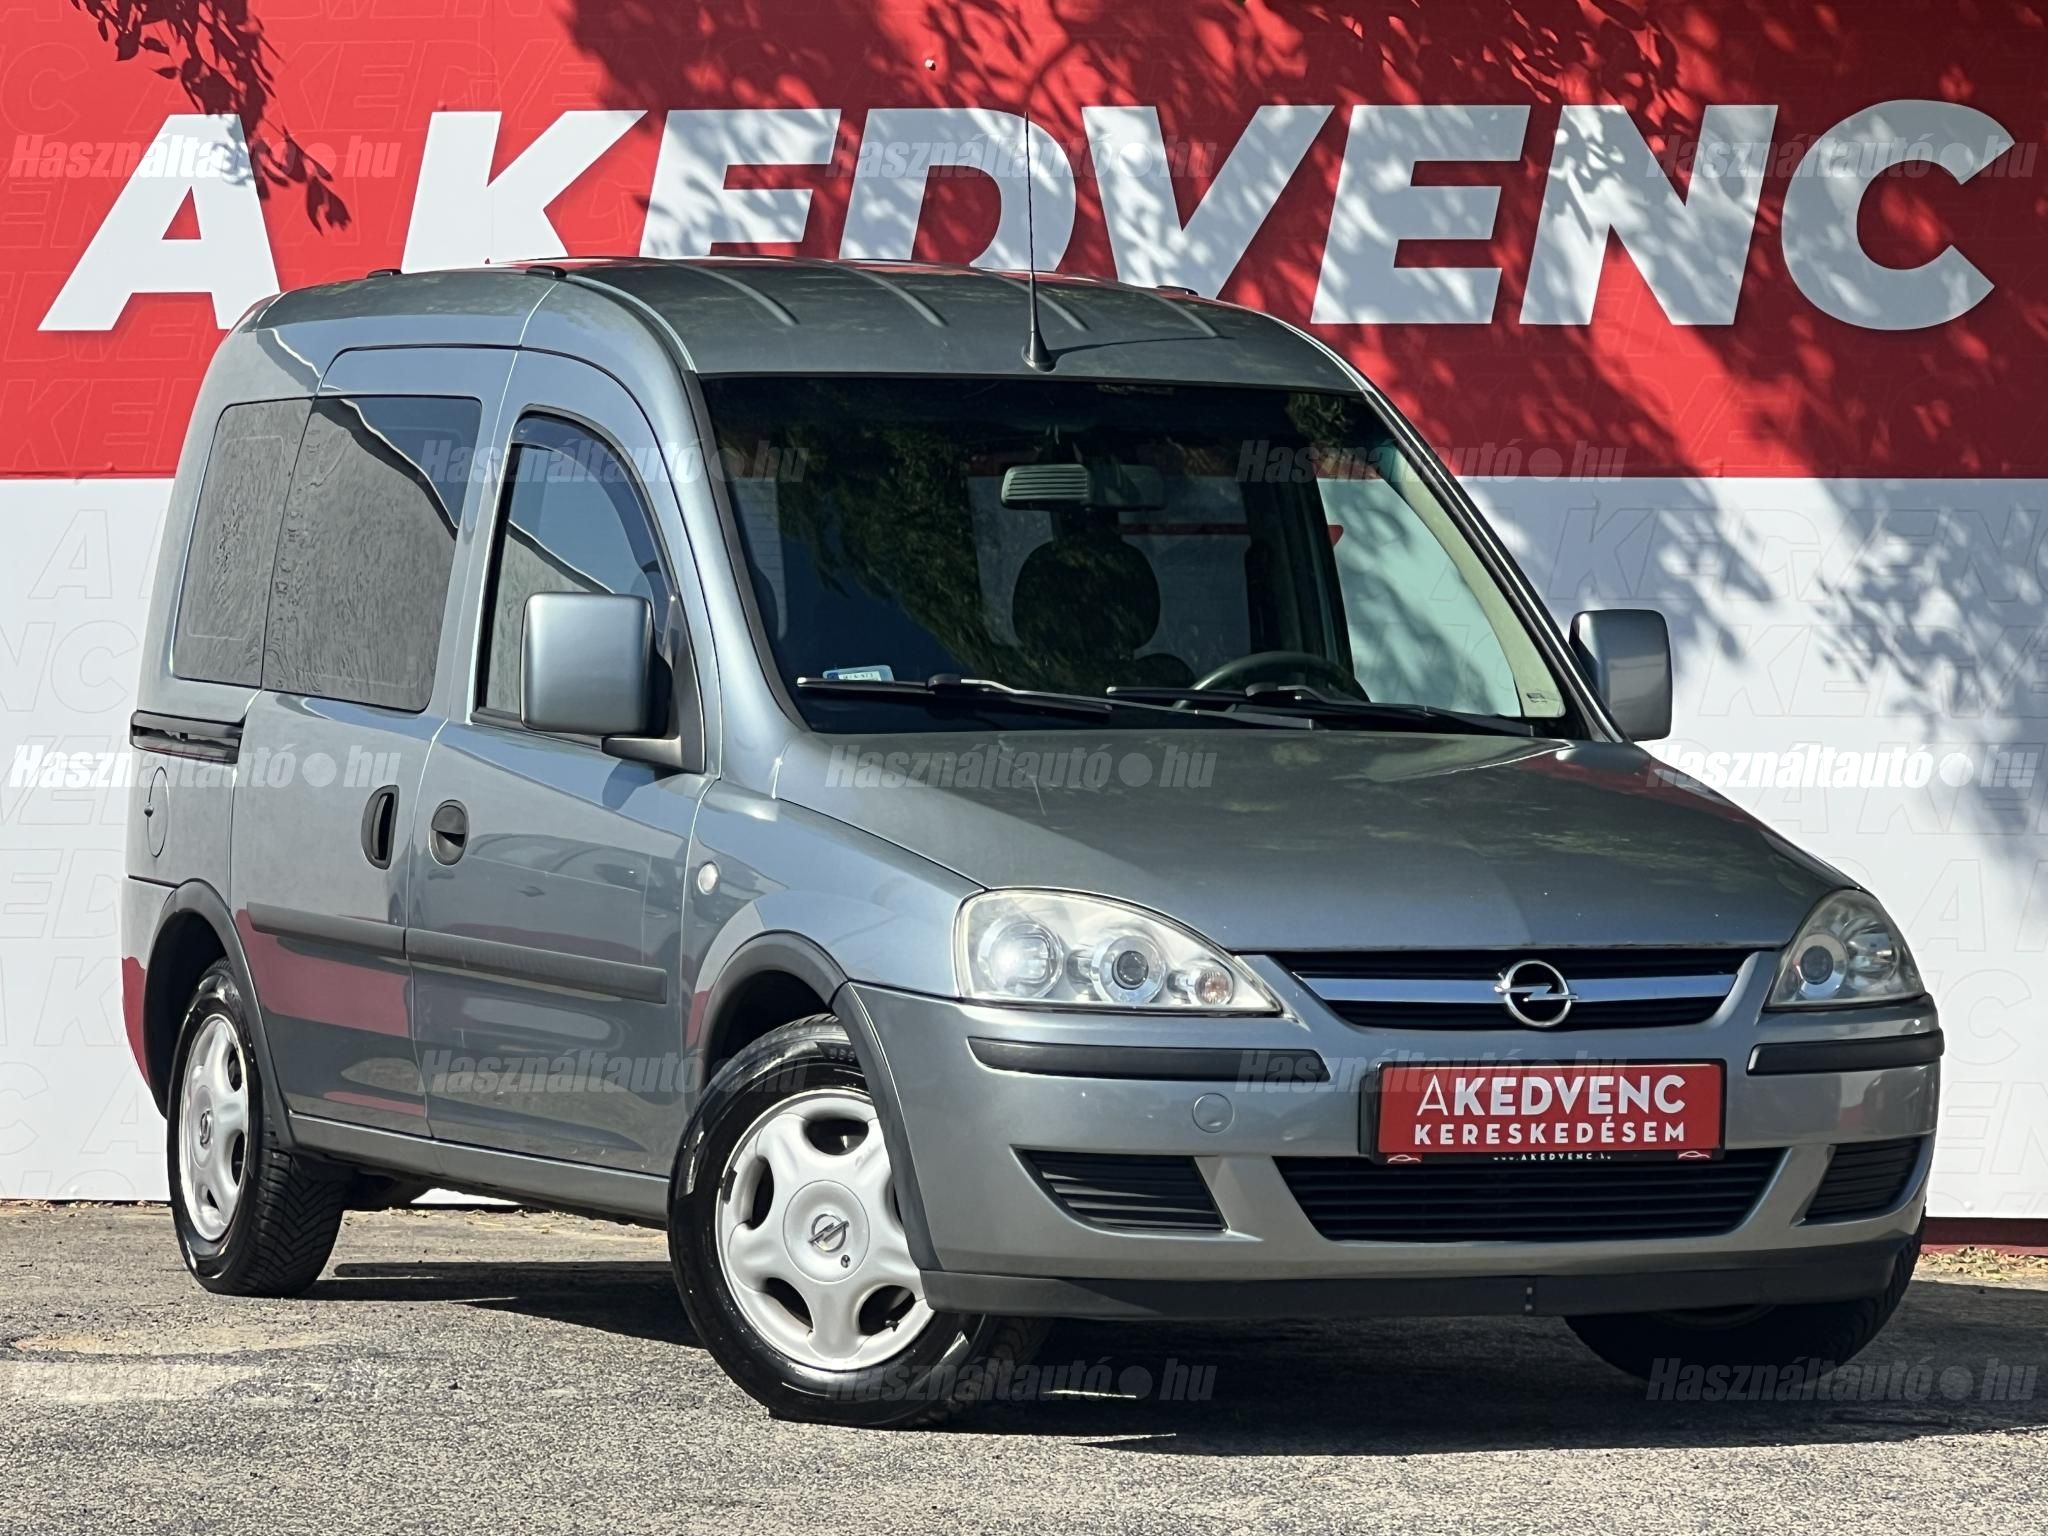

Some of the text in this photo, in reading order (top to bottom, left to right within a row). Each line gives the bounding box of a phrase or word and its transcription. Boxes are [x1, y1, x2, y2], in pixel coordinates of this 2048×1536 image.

[39, 113, 281, 331] A
[402, 99, 2014, 331] KEDVENC
[1414, 1116, 1685, 1146] KERESKEDÉSEM
